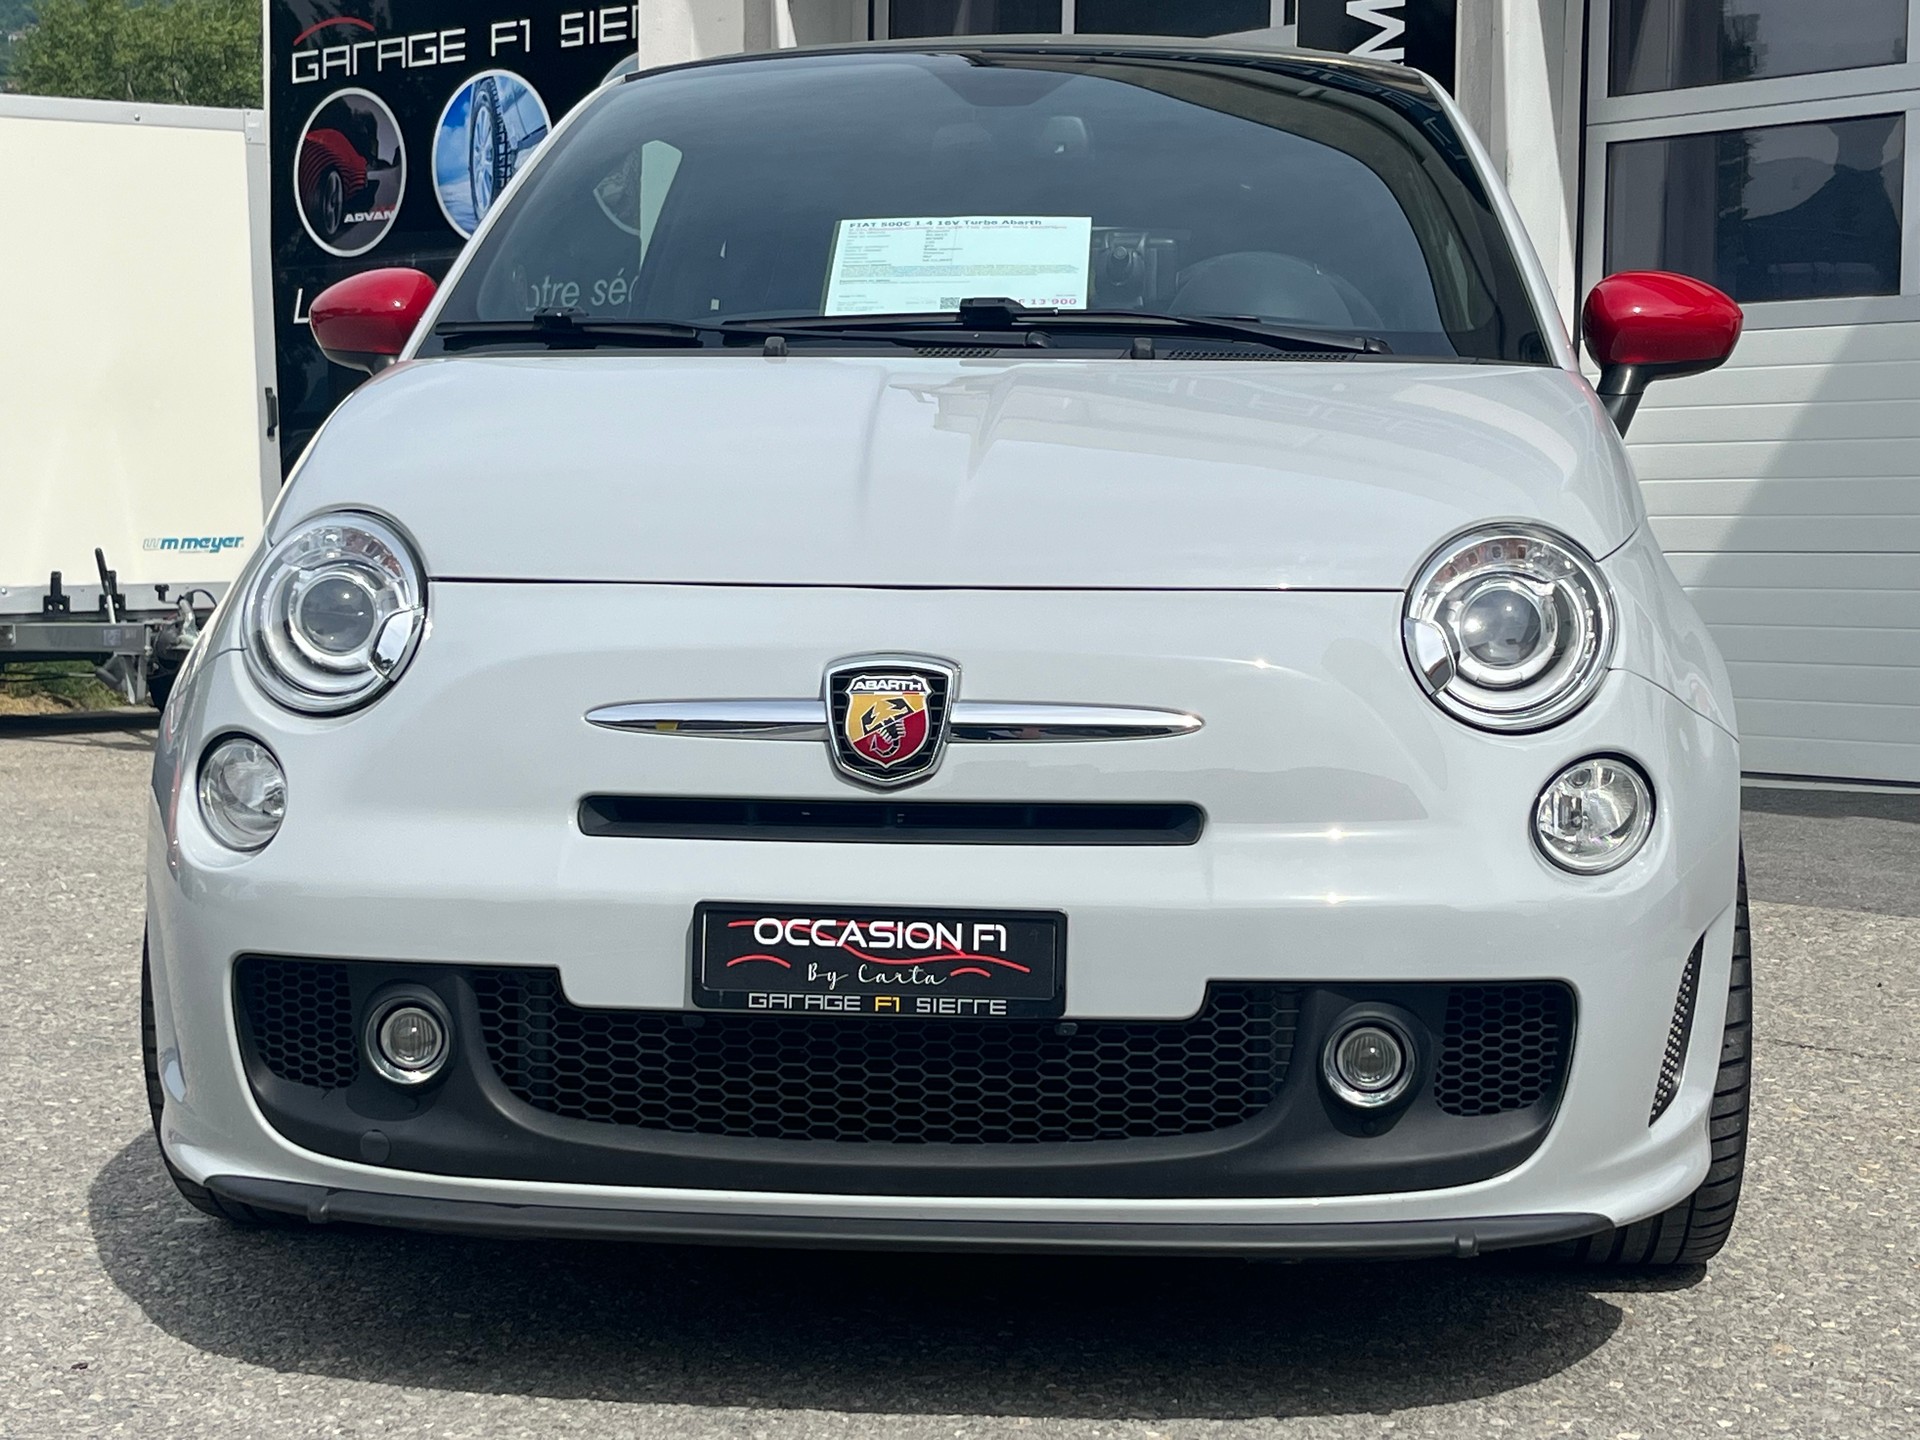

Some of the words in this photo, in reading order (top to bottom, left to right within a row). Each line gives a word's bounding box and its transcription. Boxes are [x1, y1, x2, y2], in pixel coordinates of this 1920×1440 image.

[491, 18, 531, 57] F1
[881, 220, 911, 228] 500C
[853, 680, 922, 691] ABARTH
[754, 918, 962, 950] OCCASION
[972, 923, 1007, 952] F1
[807, 962, 849, 990] By
[857, 963, 947, 986] Carta
[748, 992, 861, 1011] GARAGE
[874, 996, 900, 1012] F1
